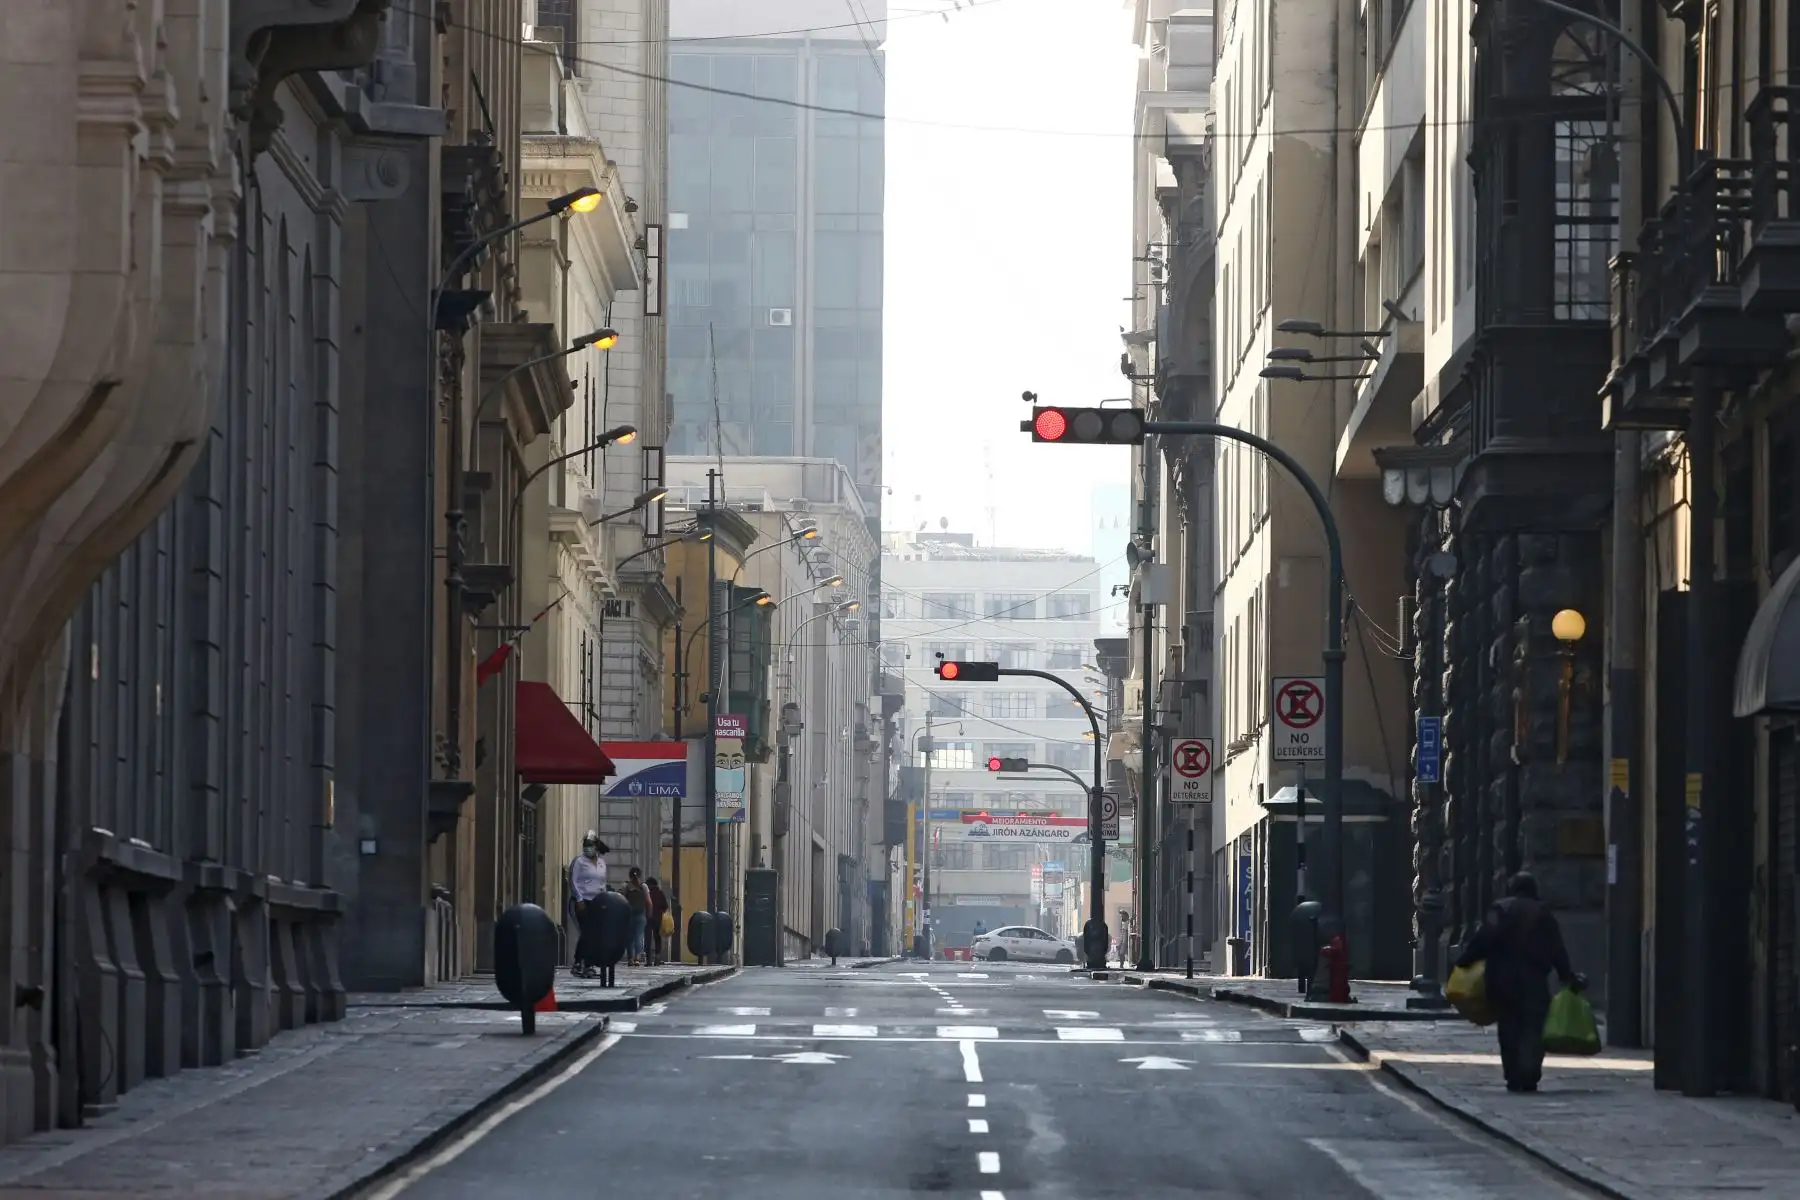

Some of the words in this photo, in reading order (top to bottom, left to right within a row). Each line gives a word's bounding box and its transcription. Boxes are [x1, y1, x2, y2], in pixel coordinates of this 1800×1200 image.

[717, 717, 731, 727] Usa
[732, 719, 740, 727] tu
[1290, 732, 1309, 744] NO
[1183, 781, 1199, 790] NO
[648, 786, 680, 795] LIMA
[991, 817, 1047, 826] MEJORAMIENTO
[991, 827, 1017, 837] JIRÓN
[1019, 827, 1070, 838] AZÁNGARO
